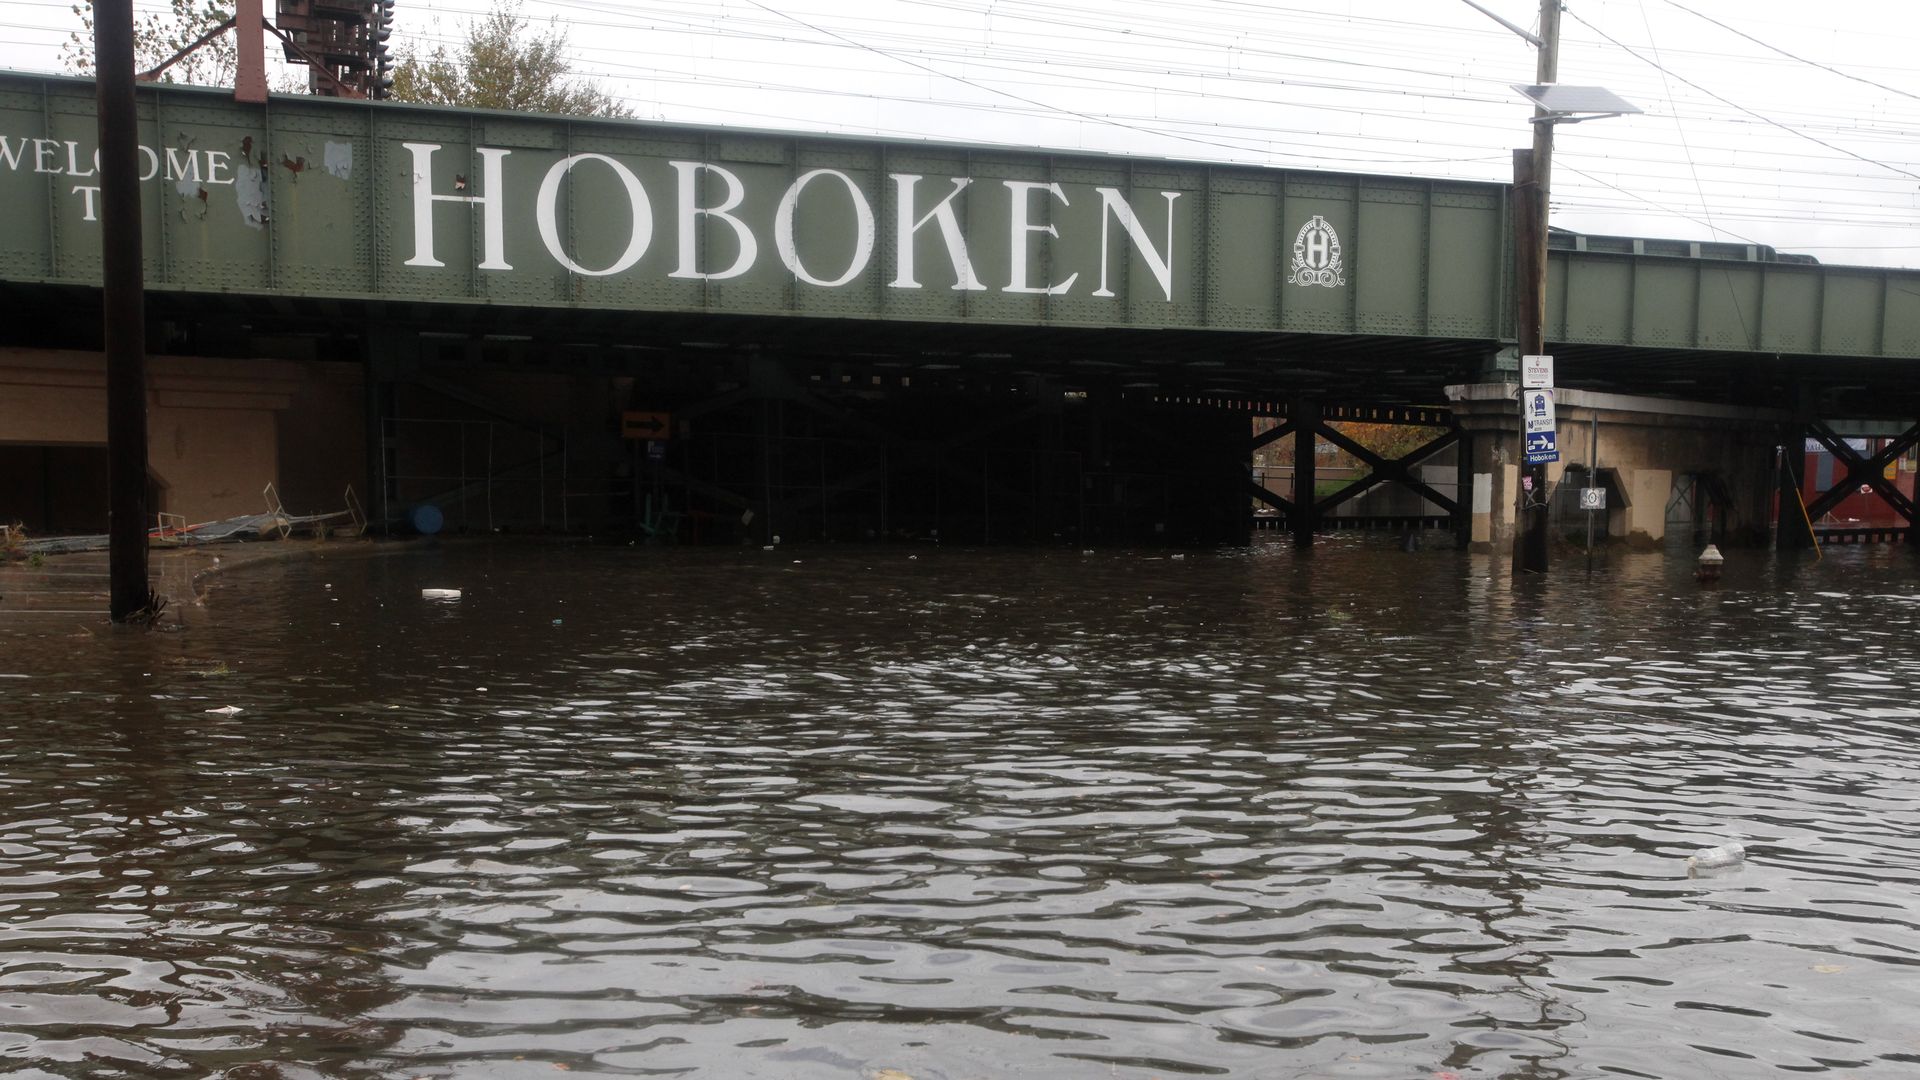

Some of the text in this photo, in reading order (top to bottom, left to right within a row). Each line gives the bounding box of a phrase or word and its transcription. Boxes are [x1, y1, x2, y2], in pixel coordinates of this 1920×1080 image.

[0, 135, 236, 185] WELOME
[402, 141, 1182, 302] HOBOKEN
[1305, 229, 1330, 269] H
[1534, 418, 1553, 426] TRANSIT
[1529, 453, 1557, 462] Hoboken
